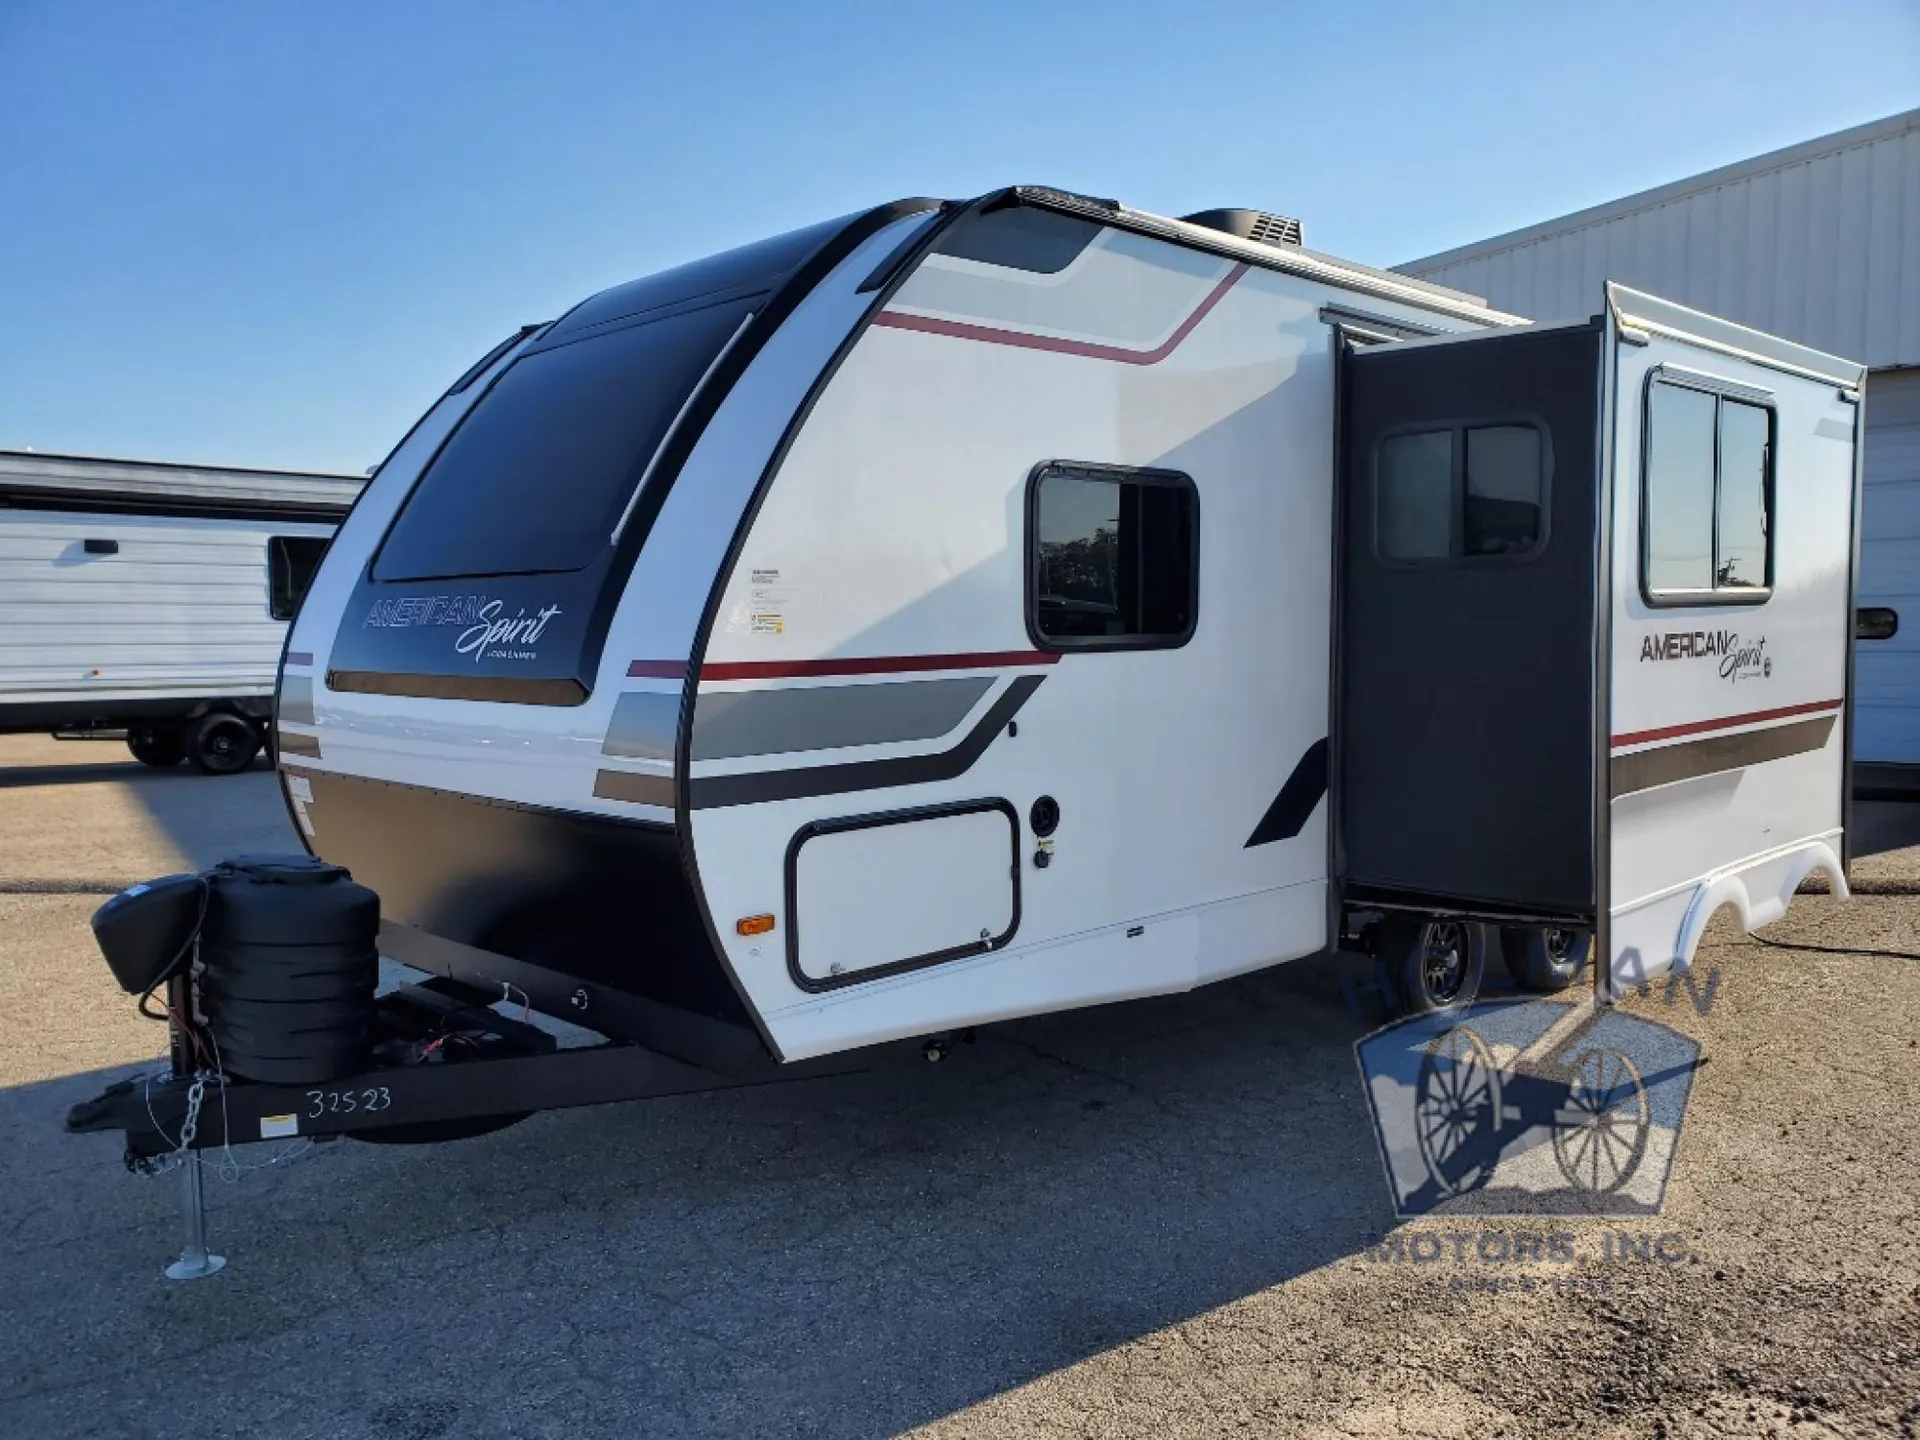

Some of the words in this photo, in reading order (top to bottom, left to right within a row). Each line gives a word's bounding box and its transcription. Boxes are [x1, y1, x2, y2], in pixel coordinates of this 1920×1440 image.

[362, 595, 487, 629] AMERICAN
[455, 600, 563, 665] Spirit
[1640, 629, 1728, 663] AMERICAN
[1719, 633, 1767, 685] Spirit
[306, 1086, 391, 1119] 32523
